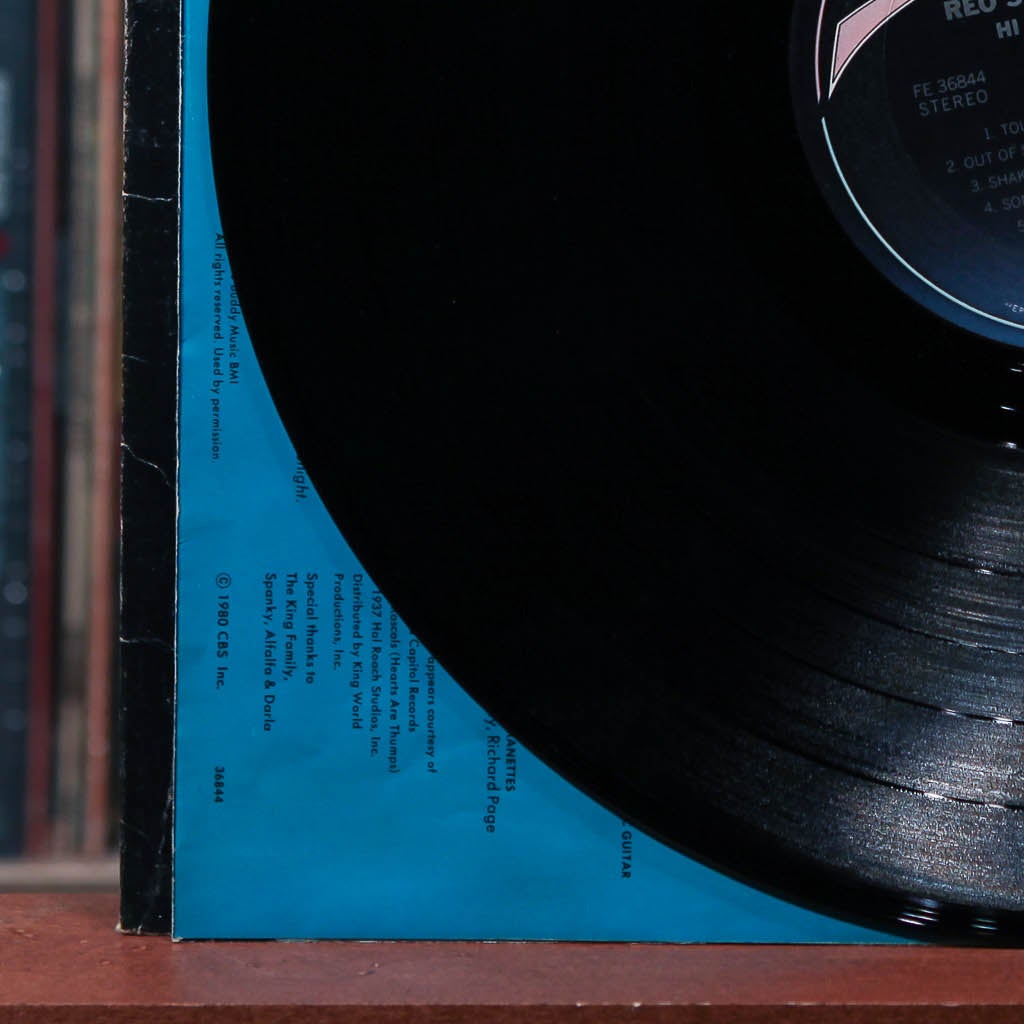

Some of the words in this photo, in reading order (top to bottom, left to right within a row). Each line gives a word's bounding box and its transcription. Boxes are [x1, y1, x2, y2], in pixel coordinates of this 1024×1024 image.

[996, 20, 1019, 40] HI
[912, 80, 933, 99] FE
[937, 70, 987, 94] 36844
[918, 88, 990, 117] STEREO
[964, 153, 993, 171] OUT
[997, 147, 1017, 162] OF
[286, 573, 298, 595] The
[304, 573, 319, 620] Special
[217, 595, 229, 626] 1980
[283, 600, 296, 629] King
[353, 574, 364, 638] Distributed
[217, 631, 228, 658] CBS
[264, 630, 277, 675] Alfalfa
[306, 625, 318, 667] thanks
[350, 643, 363, 656] by
[407, 638, 421, 682] Capitol
[264, 680, 276, 689] &
[306, 672, 315, 684] to
[350, 662, 363, 688] King
[264, 695, 276, 731] Darla
[352, 692, 363, 729] World
[408, 687, 419, 732] Records
[487, 735, 501, 791] Richard
[214, 767, 224, 803] 36844
[483, 796, 500, 832] Page
